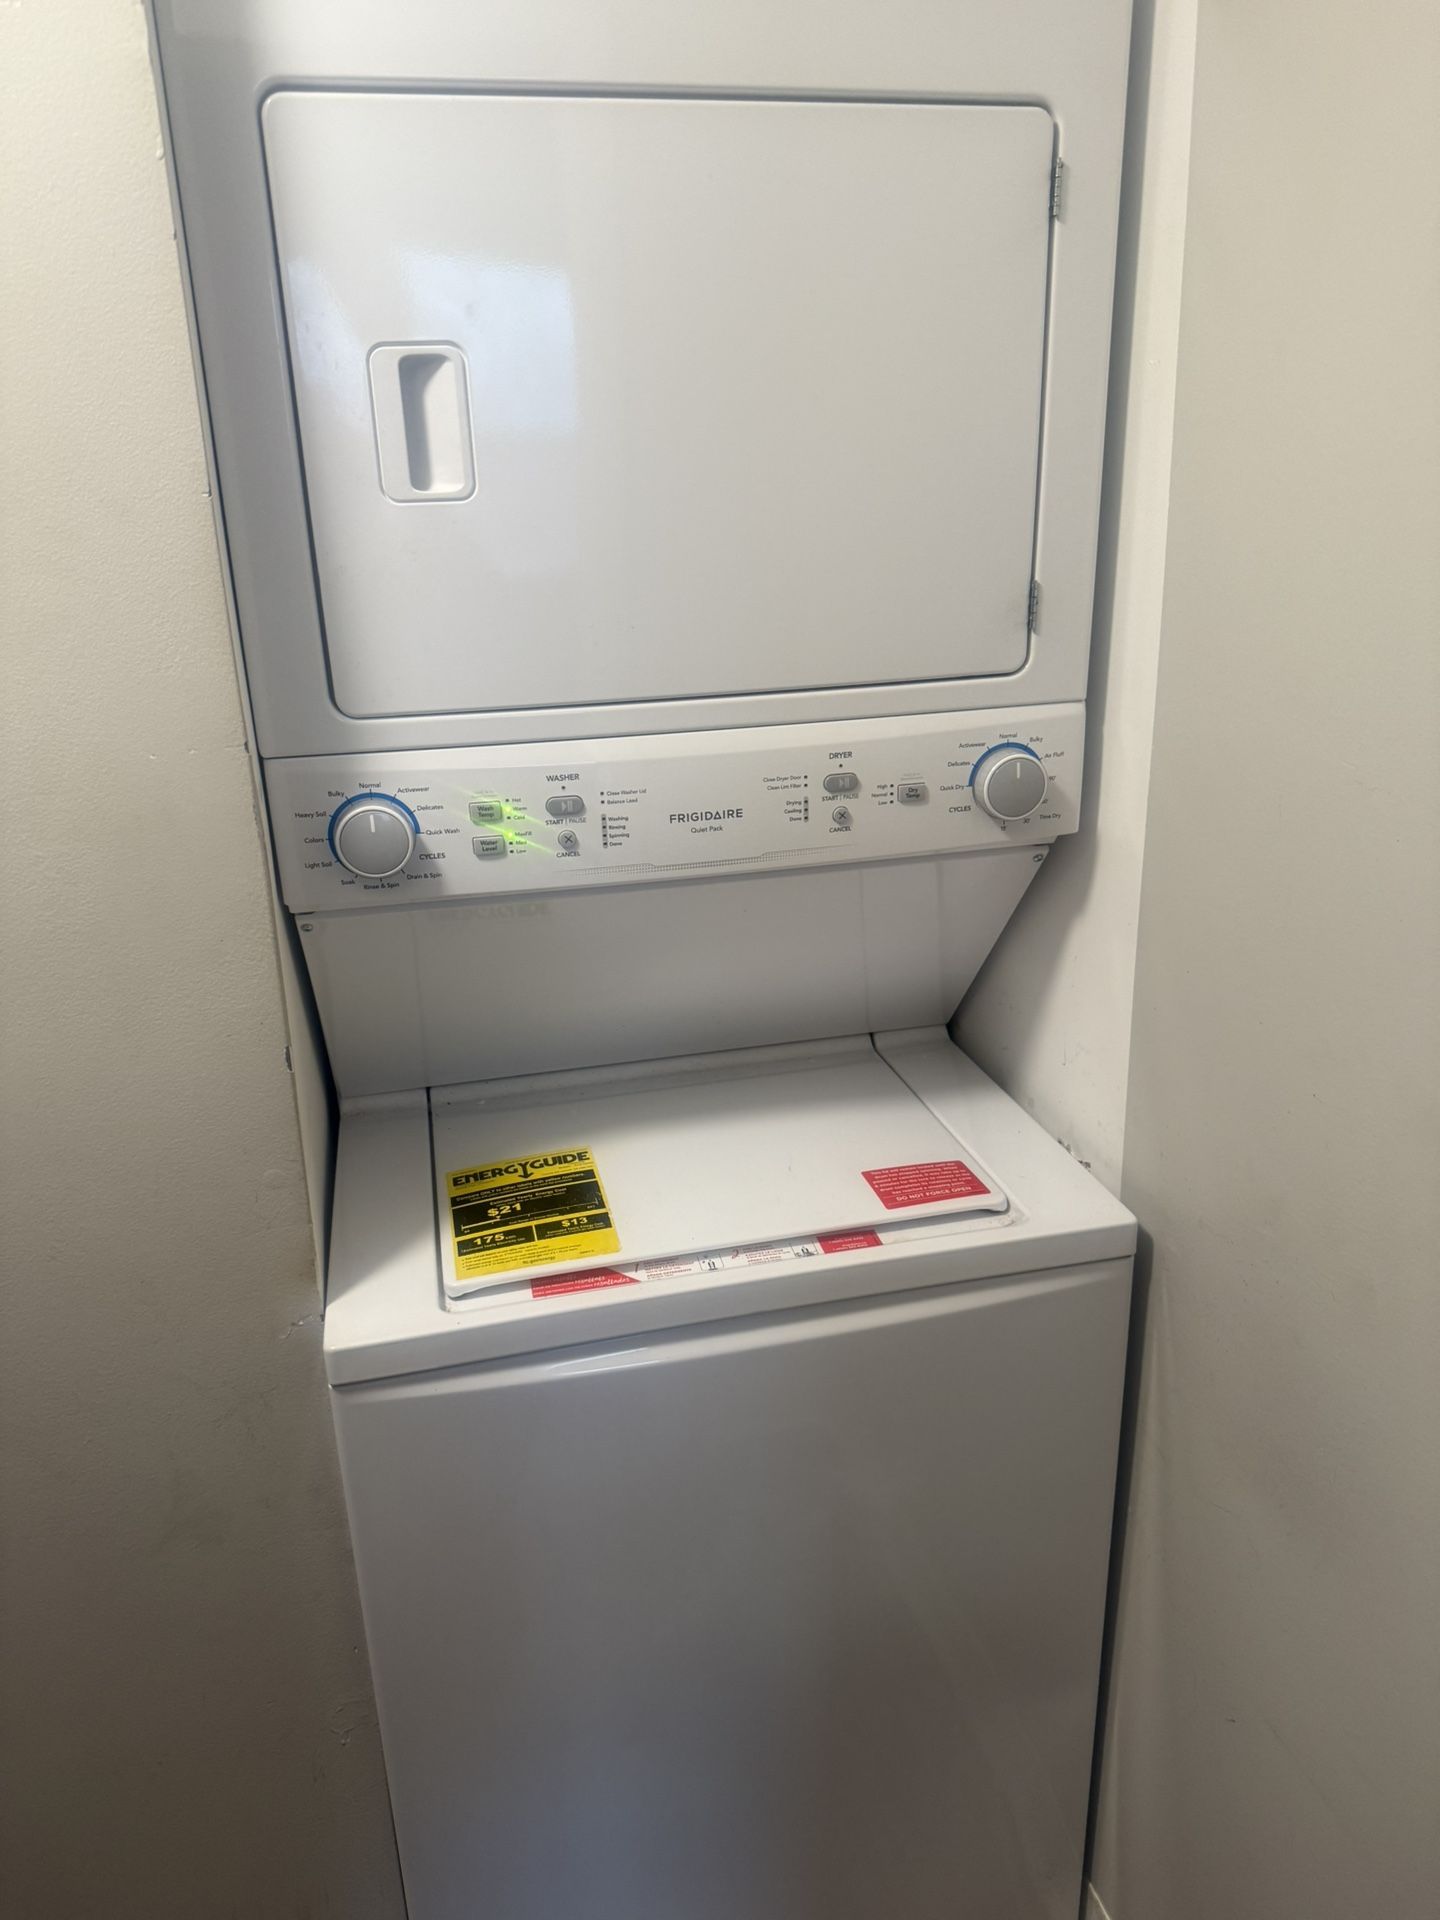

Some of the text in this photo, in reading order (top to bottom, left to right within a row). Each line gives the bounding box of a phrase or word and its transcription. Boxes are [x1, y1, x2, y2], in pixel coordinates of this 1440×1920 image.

[999, 732, 1018, 740] Normal
[1029, 735, 1043, 743] Bulky
[958, 741, 987, 749] Activewear
[829, 751, 852, 760] DRYER
[947, 760, 971, 768] Delicates
[545, 773, 580, 782] WASHER
[358, 781, 381, 790] Normal
[397, 786, 430, 794] Activewear
[940, 784, 954, 792] Quick
[328, 790, 344, 798] Bulky
[821, 792, 860, 802] START PAUSE
[416, 804, 444, 812] Delicates
[948, 805, 972, 813] CYCLES
[294, 810, 327, 819] Heavy Soil
[669, 807, 744, 825] FRIGIDAIRE
[568, 817, 587, 825] PAUSE
[443, 827, 460, 835] Wash
[690, 825, 723, 834] Quiet Pack
[828, 825, 852, 834] CANCEL
[419, 852, 446, 861] CYCLES
[304, 860, 333, 870] Light Soil
[429, 872, 443, 880] Spin
[363, 882, 380, 890] Rinse
[386, 881, 400, 890] Spin
[908, 1192, 924, 1200] NOT
[925, 1188, 950, 1197] FORCE
[951, 1186, 972, 1194] OPEN
[487, 1203, 522, 1218] $21
[561, 1216, 588, 1228] $13
[473, 1232, 505, 1246] 175
